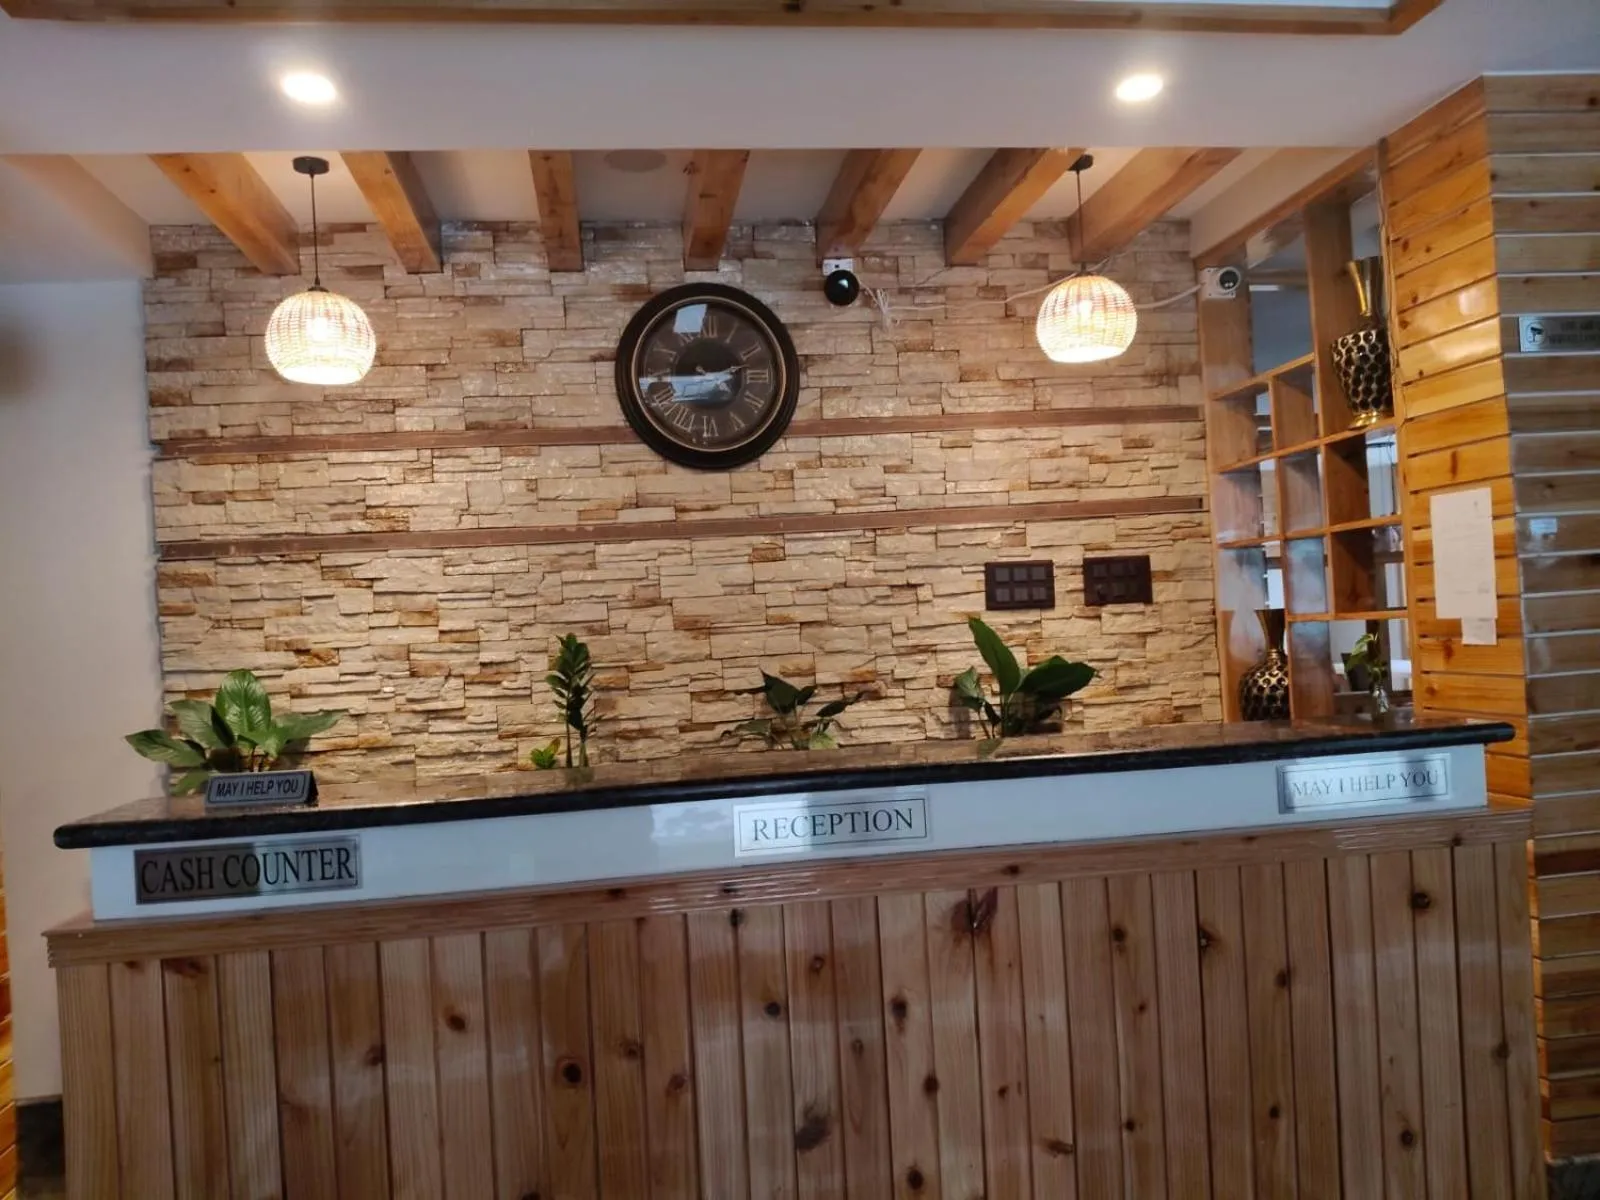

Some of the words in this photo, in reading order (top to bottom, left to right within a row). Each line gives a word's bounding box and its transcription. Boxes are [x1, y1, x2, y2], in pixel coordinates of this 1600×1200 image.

[746, 369, 769, 385] III
[216, 781, 239, 797] MAY
[240, 780, 245, 796] I
[246, 779, 274, 796] HELP
[276, 778, 299, 794] YOU
[1292, 777, 1335, 797] MAY
[1339, 777, 1345, 793] I
[1350, 772, 1397, 793] HELP
[1400, 769, 1439, 788] YOU
[753, 808, 913, 842] RECEPTION
[140, 856, 216, 895] CASH
[222, 847, 354, 889] COUNTER
